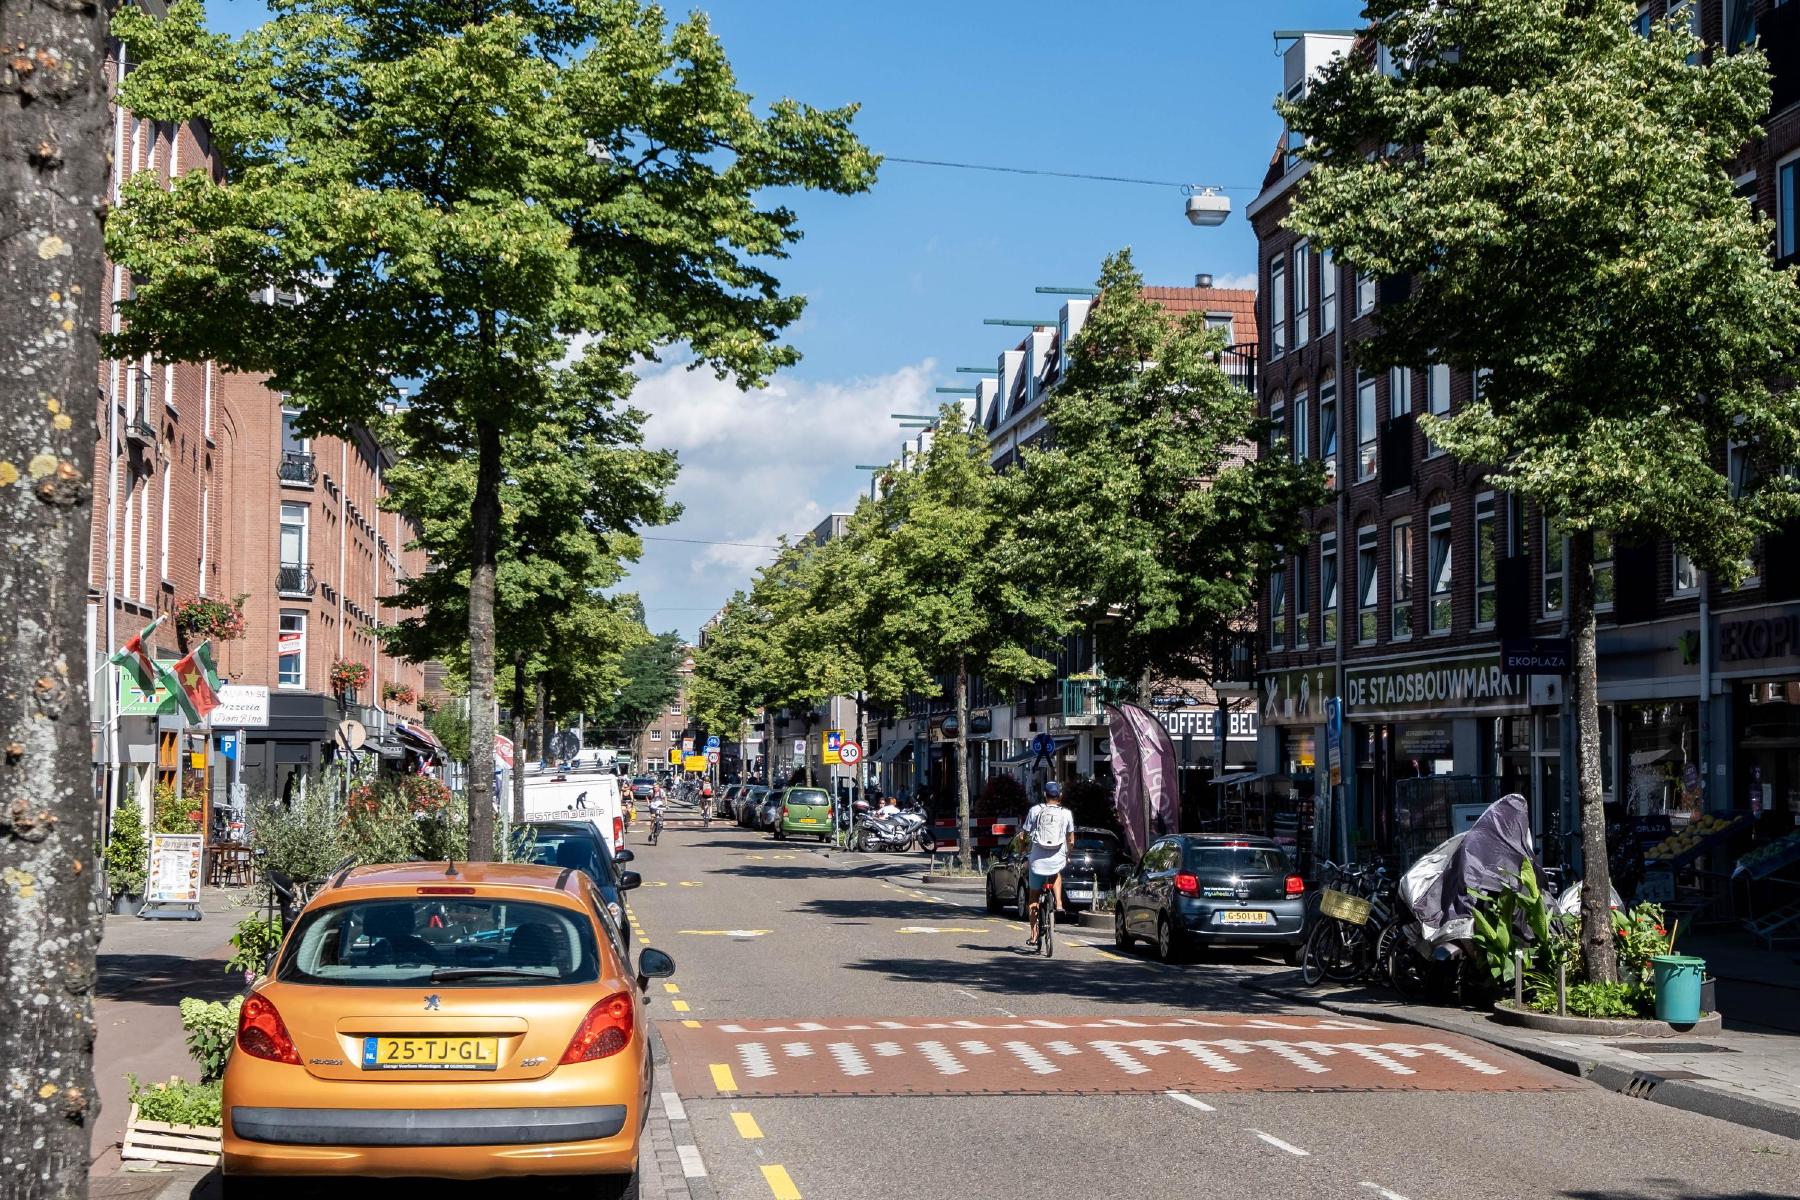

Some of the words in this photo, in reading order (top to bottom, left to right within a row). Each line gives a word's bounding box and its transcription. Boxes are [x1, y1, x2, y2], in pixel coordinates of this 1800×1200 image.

[1508, 656, 1566, 667] EKOPLAZA
[1350, 679, 1366, 706] DE
[1369, 665, 1521, 705] STADSBOUWMARKT
[1160, 713, 1214, 734] COFFEE
[225, 742, 232, 752] P
[843, 748, 857, 758] 30
[387, 1041, 487, 1061] 25-TJ-GL
